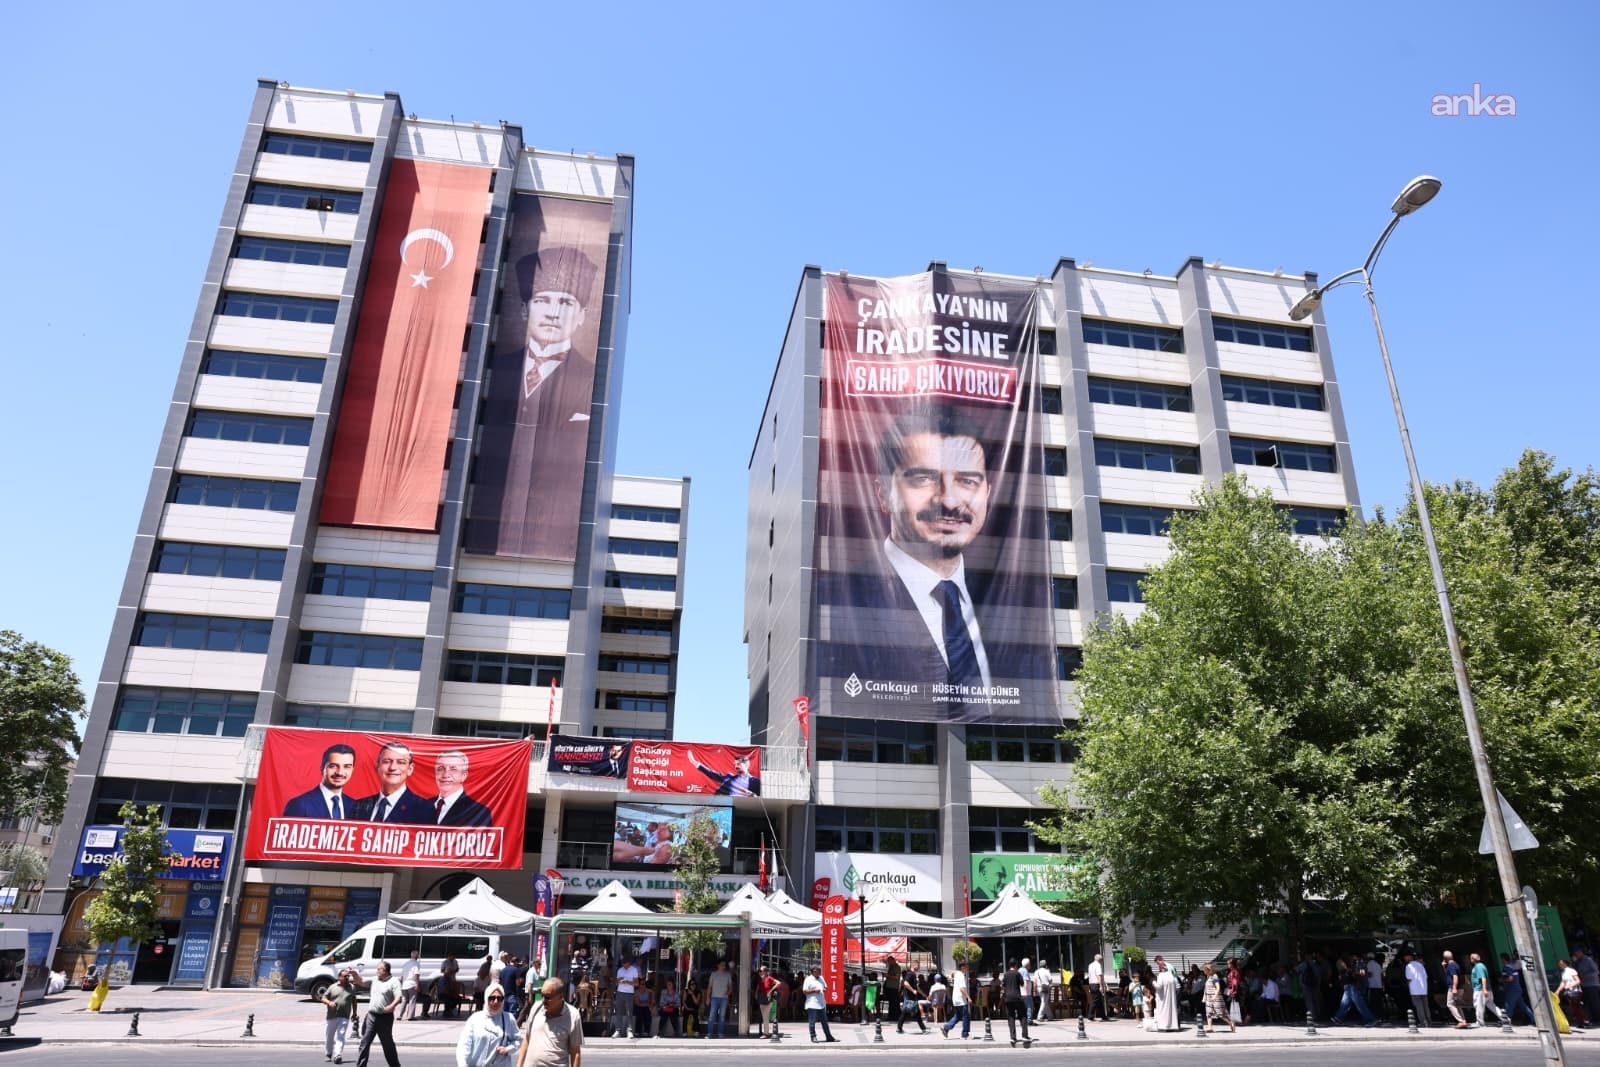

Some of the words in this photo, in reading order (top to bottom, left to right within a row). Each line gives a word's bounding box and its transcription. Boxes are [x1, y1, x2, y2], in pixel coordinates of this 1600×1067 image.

[857, 293, 1008, 323] ÇANKAYA'NIN
[856, 321, 1010, 360] İRADESİNE
[854, 366, 911, 393] SAHİP
[916, 364, 1011, 398] ÇIKIYORUZ
[932, 682, 969, 695] HÜSEYİN
[970, 686, 988, 696] CAN
[990, 685, 1020, 697] GÜNER
[634, 745, 672, 756] Çankaya
[633, 756, 670, 767] Gençliği
[632, 777, 668, 788] Yanında
[272, 823, 357, 852] İRADEMİZE
[361, 827, 410, 854] SAHİP
[414, 832, 496, 860] ÇIKIYORUZ
[586, 878, 642, 890] ÇANAYA
[824, 917, 843, 925] DİSK
